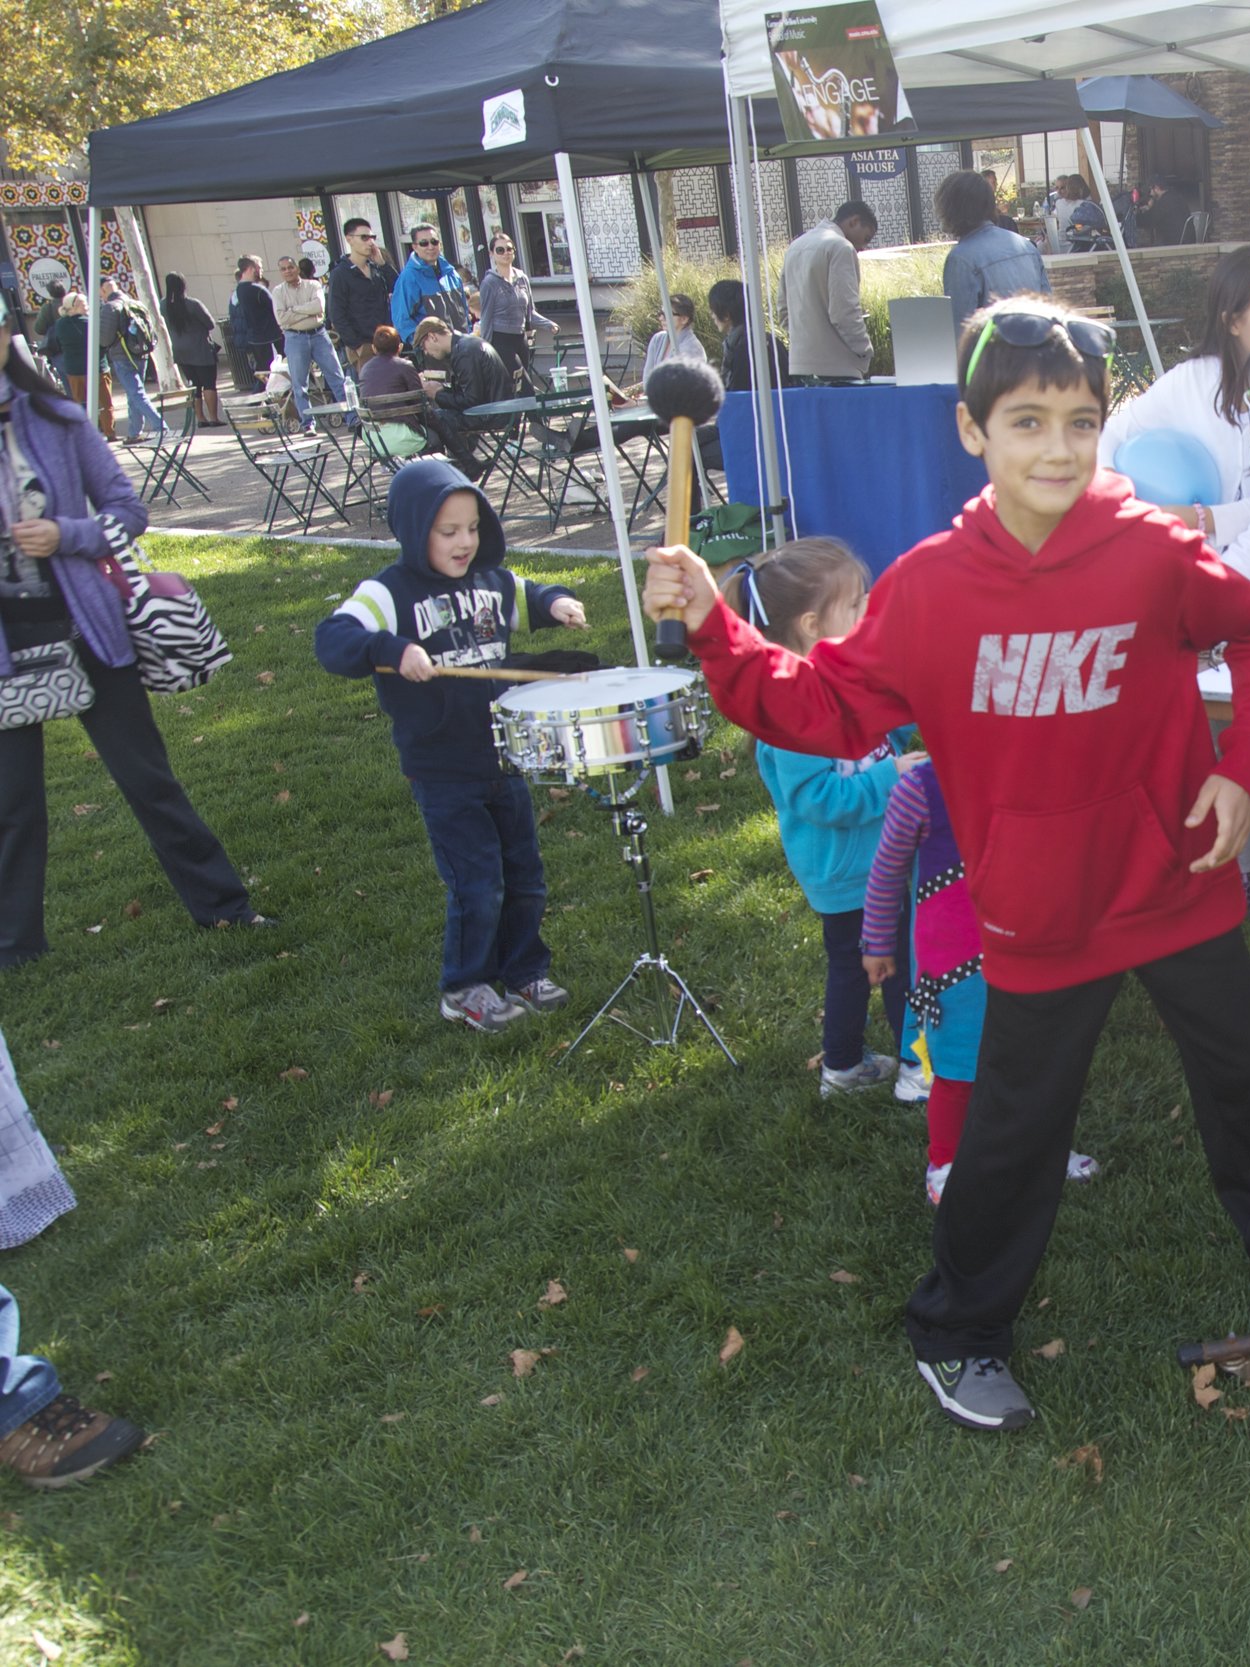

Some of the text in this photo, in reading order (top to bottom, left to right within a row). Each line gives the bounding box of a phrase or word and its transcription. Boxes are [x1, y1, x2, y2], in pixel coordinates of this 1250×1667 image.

[802, 78, 880, 107] ENGAGE
[850, 149, 899, 162] ASIA TEA
[856, 161, 896, 173] HOUSE
[31, 271, 68, 281] PALESTINIAN
[971, 621, 1138, 717] NIKE
